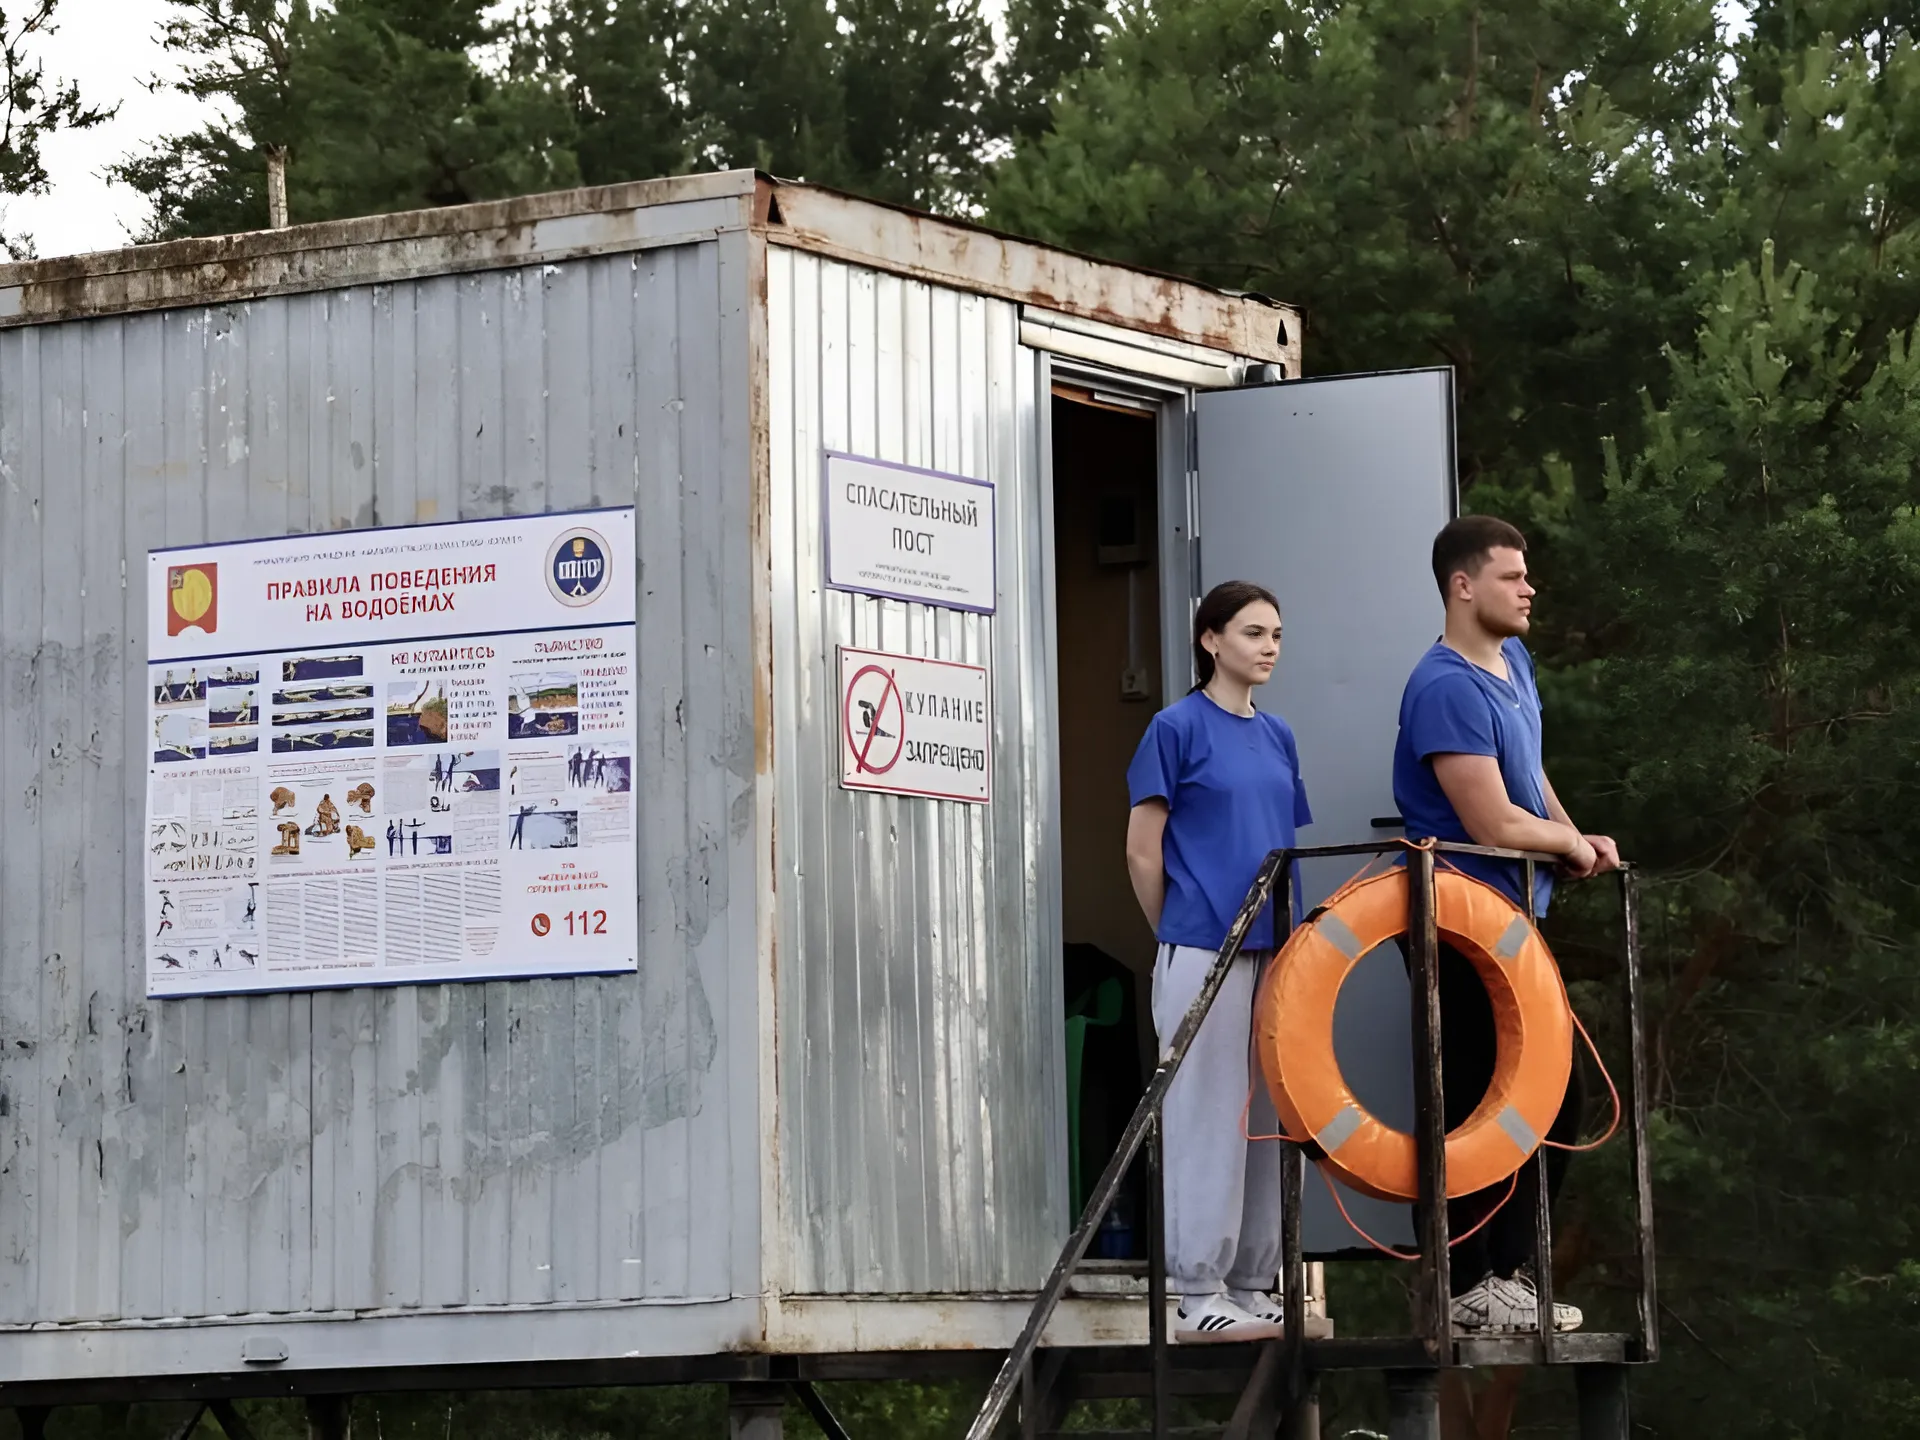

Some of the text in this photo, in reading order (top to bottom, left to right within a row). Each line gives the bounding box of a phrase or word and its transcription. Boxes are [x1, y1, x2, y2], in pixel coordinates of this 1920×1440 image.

[846, 482, 978, 527] СПАСАТЕЛЬНЫЙ
[892, 527, 935, 556] ПОСТ
[267, 563, 497, 601] ПРАВИЛА ПОВЕДЕНИЯ
[306, 591, 455, 622] НА ВОДОЁМАХ
[905, 690, 983, 724] КУПАНИЕ
[905, 740, 985, 772] ЗАПРЕЩЕНО
[563, 909, 608, 936] 112
